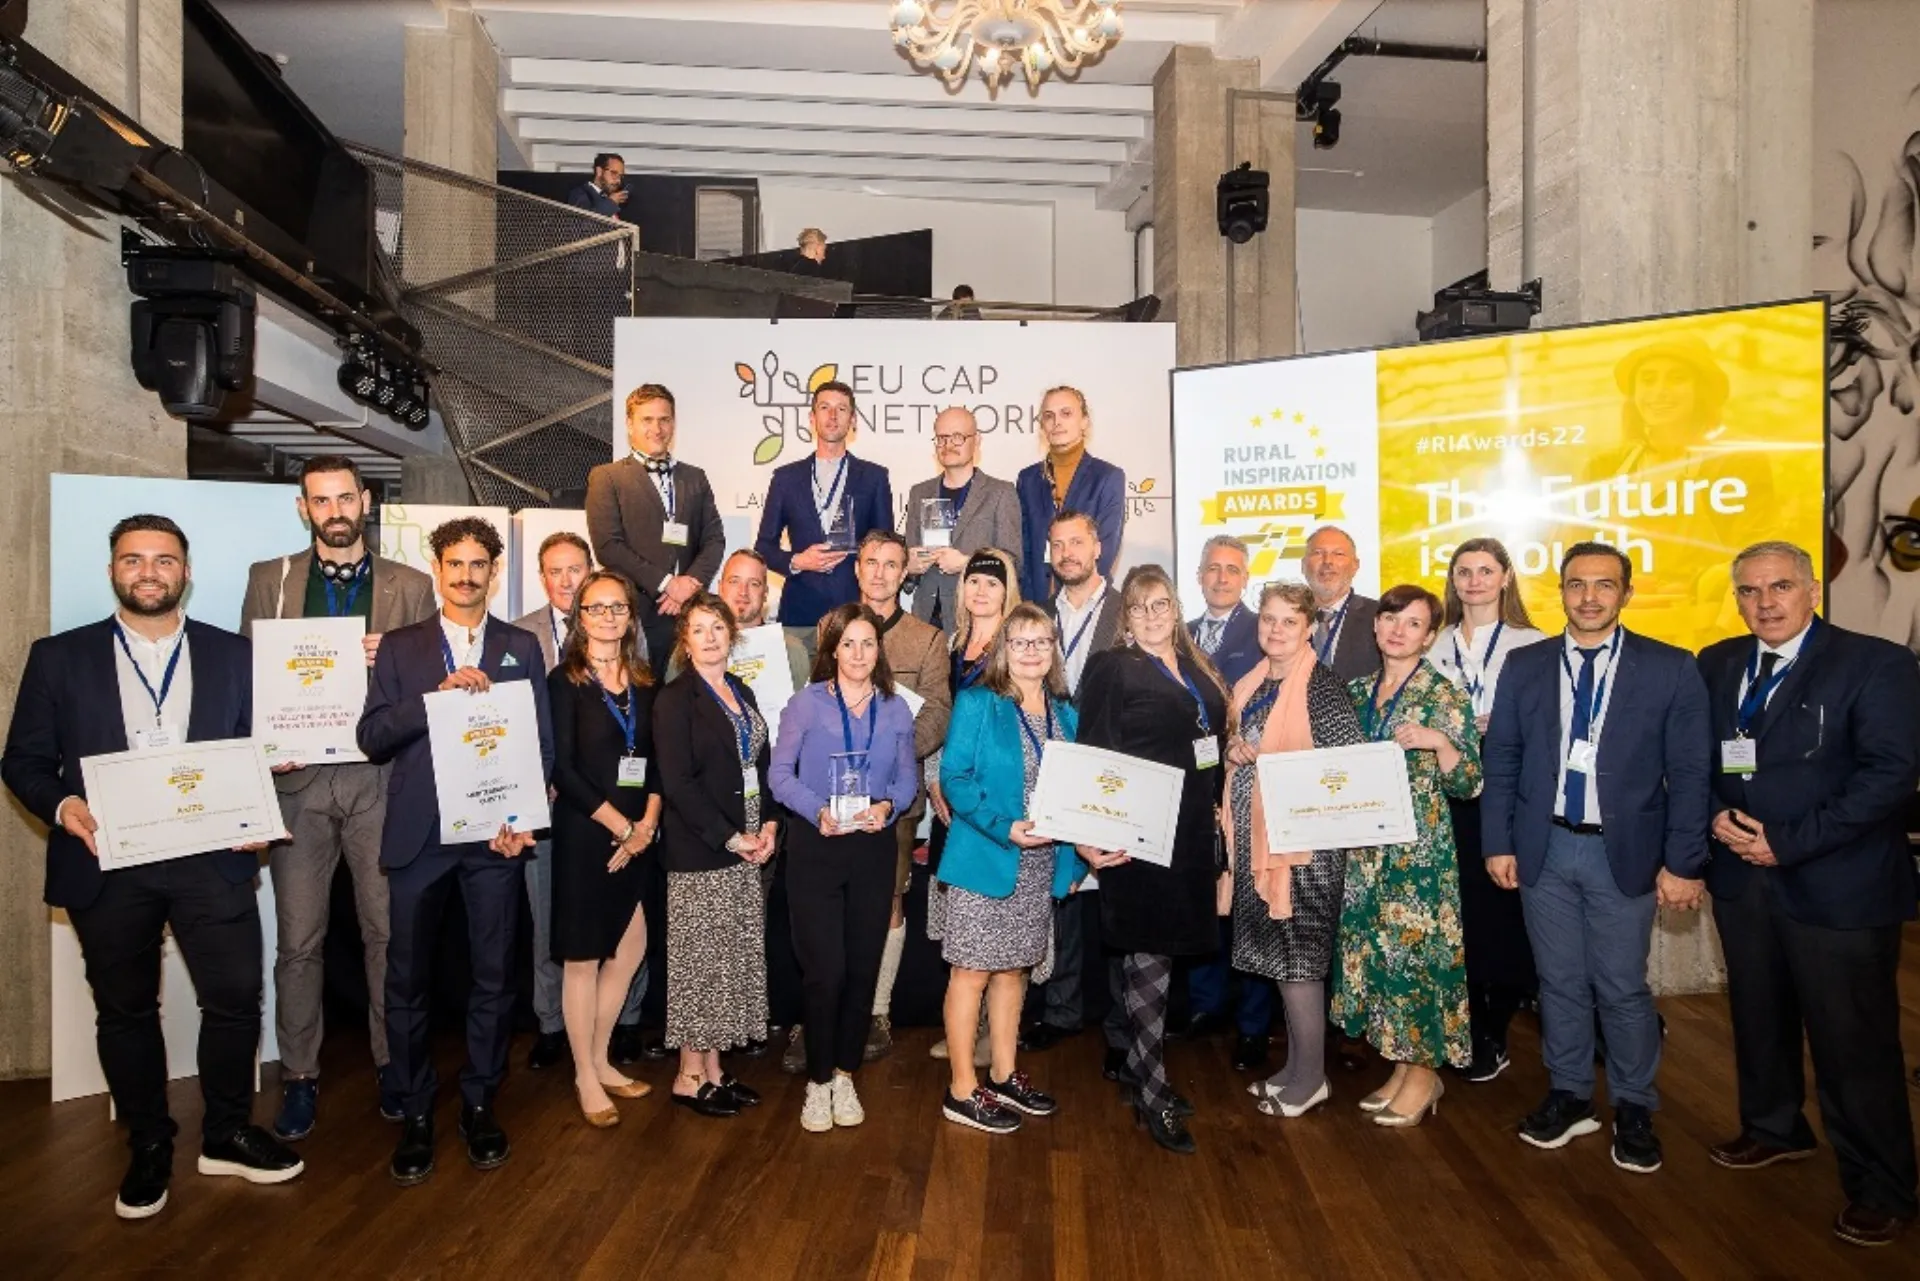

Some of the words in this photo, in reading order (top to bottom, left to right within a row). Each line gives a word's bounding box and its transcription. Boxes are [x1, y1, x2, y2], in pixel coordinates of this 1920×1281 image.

[852, 365, 903, 394] EU
[921, 365, 998, 394] CAP
[854, 404, 1041, 434] NETORK
[1223, 443, 1297, 464] RURAL
[1415, 425, 1586, 454] #RIAwards22
[1223, 461, 1357, 487] INSPIRATION
[1223, 491, 1318, 513] AWARDS
[1540, 473, 1748, 519] Future
